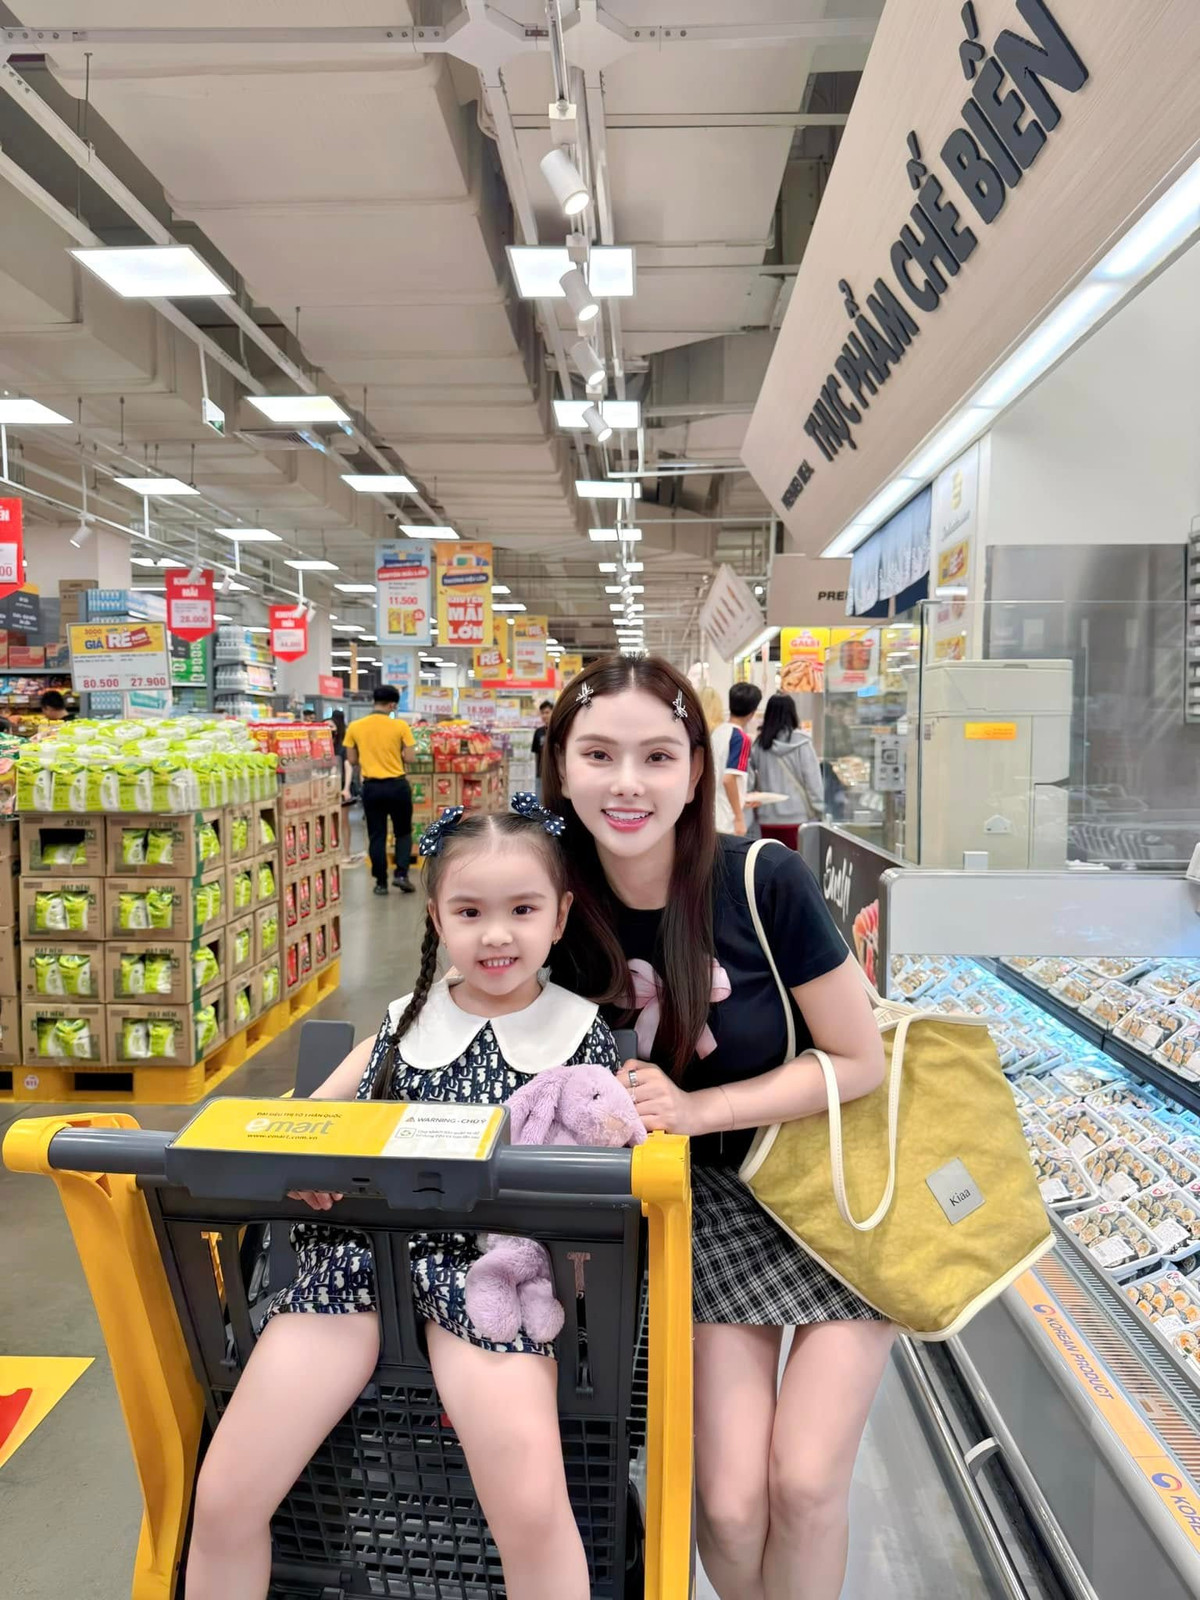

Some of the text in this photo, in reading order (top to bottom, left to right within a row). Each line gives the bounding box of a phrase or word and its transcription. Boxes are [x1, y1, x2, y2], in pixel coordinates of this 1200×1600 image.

[803, 0, 1089, 462] THỰC PHẨM CHẾ BIẾN
[389, 596, 418, 606] 11.500
[817, 591, 848, 601] PRE
[448, 603, 483, 621] MÃI
[107, 626, 133, 649] RẺ
[448, 622, 484, 639] LỚN
[83, 678, 120, 689] 80.500
[130, 677, 167, 687] 27.900
[823, 845, 853, 923] Sushi
[246, 1117, 334, 1135] emart
[949, 1187, 971, 1207] Kiaa
[1044, 1316, 1114, 1400] KOREAN PRODUCT
